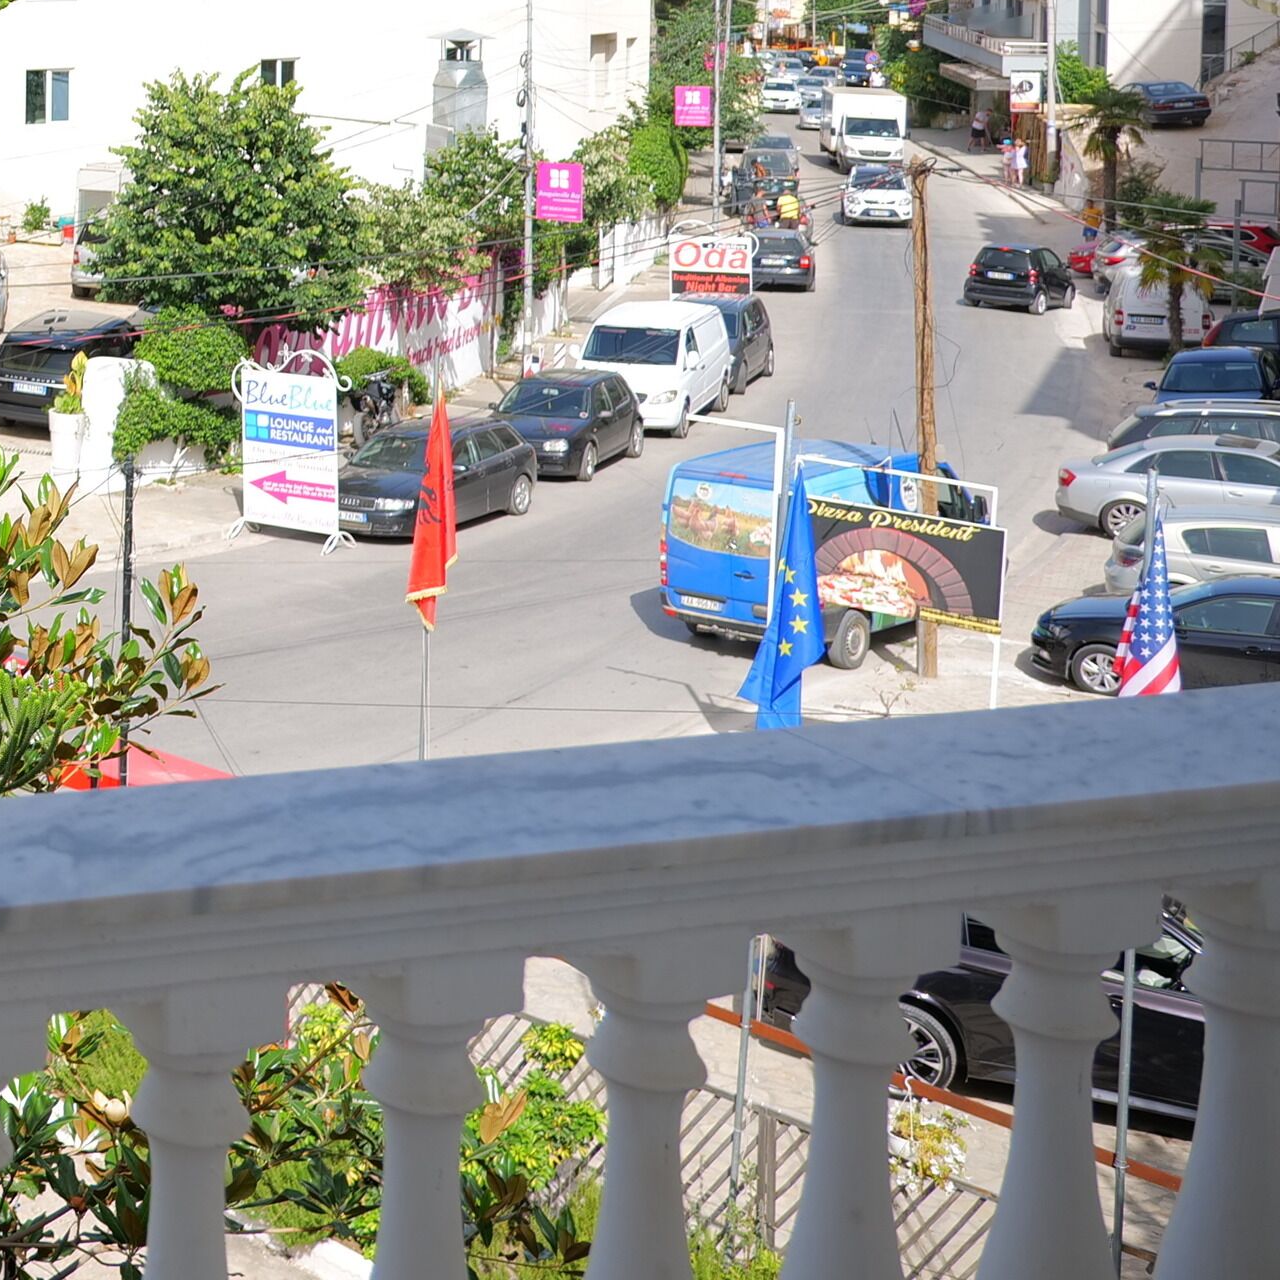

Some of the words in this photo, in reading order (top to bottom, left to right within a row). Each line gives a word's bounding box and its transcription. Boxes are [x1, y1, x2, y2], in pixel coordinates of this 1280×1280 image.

[674, 241, 748, 269] Oda
[673, 273, 713, 283] Traditional
[715, 275, 749, 284] Albanian
[685, 282, 716, 292] Night
[718, 283, 738, 293] Bar
[270, 417, 314, 433] LOUNGE
[316, 425, 333, 435] and
[270, 428, 334, 447] RESTAURANT
[868, 511, 981, 542] President
